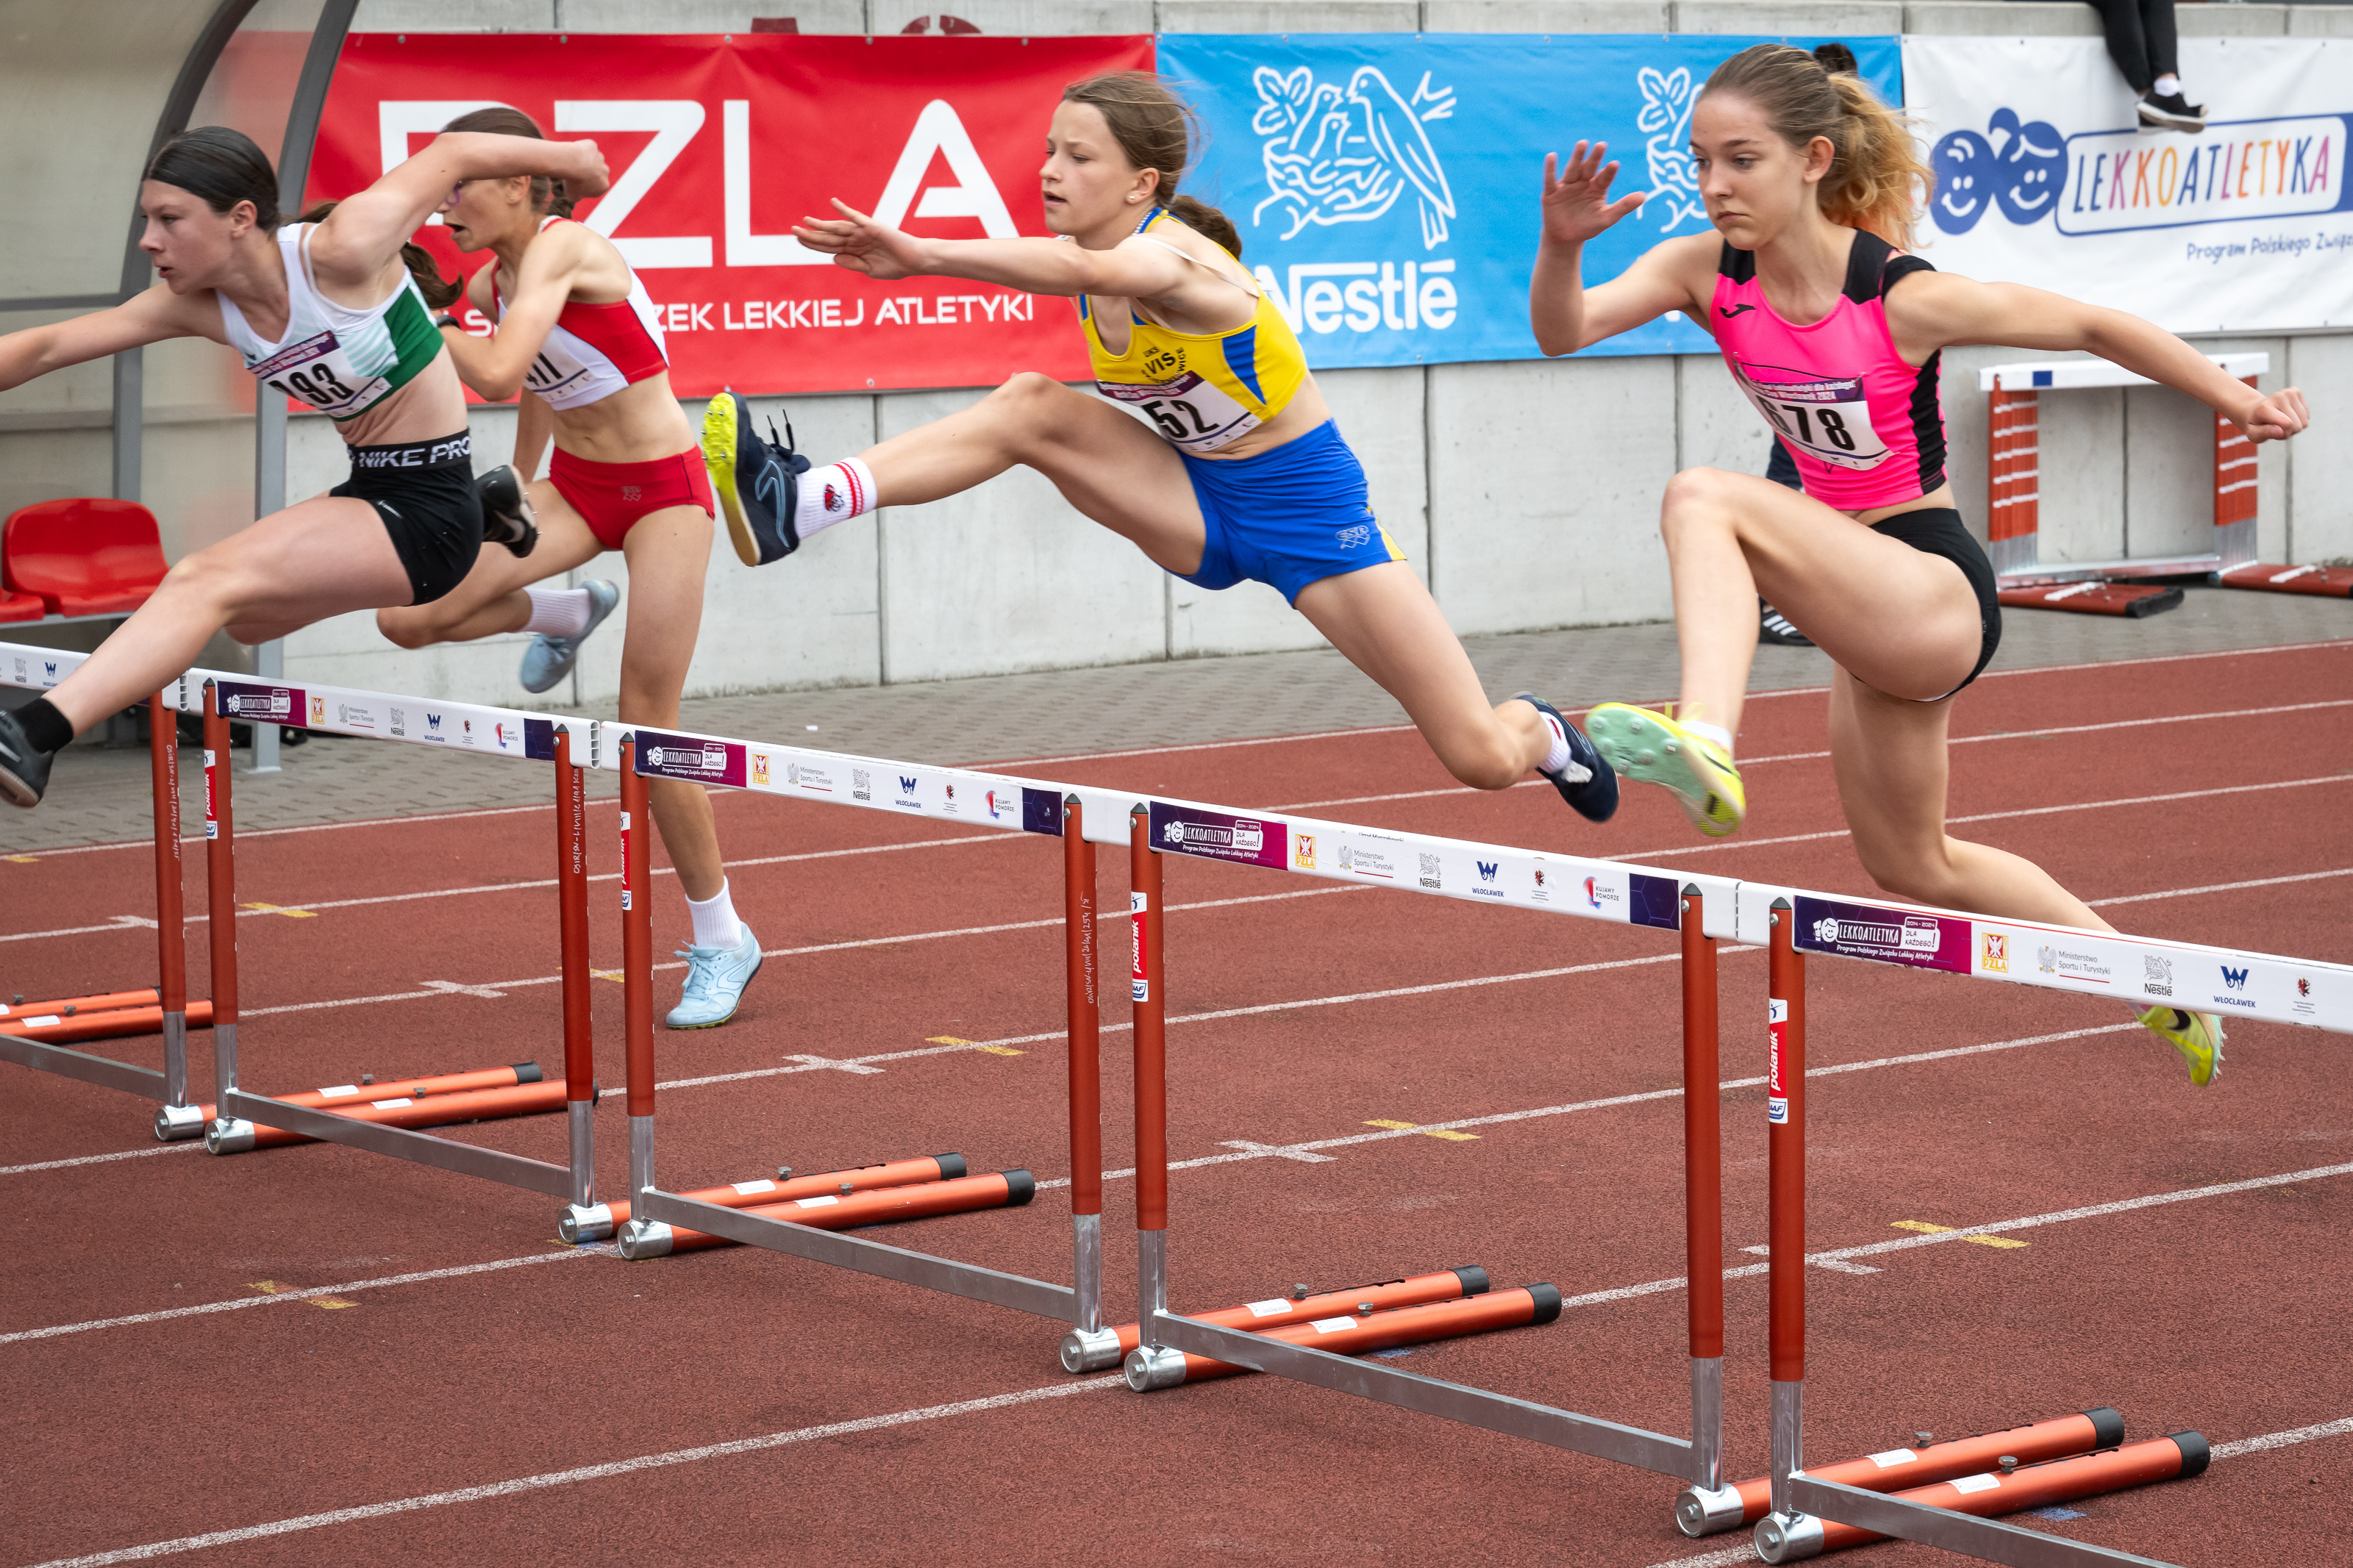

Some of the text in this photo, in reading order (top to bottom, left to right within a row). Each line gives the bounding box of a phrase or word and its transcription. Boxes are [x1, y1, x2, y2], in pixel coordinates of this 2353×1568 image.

[2073, 135, 2330, 212] LEKKOATLETYKA
[2187, 243, 2246, 265] Program
[2250, 234, 2311, 257] Polskiego
[1254, 259, 1458, 335] Nestlé
[724, 298, 864, 330] LEKKIEJ
[874, 294, 1033, 326] ATLETYKI
[1145, 352, 1176, 375] VIS
[1755, 395, 1856, 451] 678
[359, 448, 426, 468] NIKE
[429, 437, 471, 464] PRO
[800, 766, 824, 776] Ministerstwo
[753, 774, 769, 784] PZLA
[800, 774, 812, 782] Sportu
[815, 776, 832, 785] Turystyki
[895, 799, 921, 809] WŁOCŁAWEK
[1184, 827, 1231, 843] LEKKOATLETYKA
[1296, 856, 1315, 867] PZLA
[1354, 850, 1384, 861] Ministerstwo
[1354, 859, 1369, 867] Sportu
[1373, 861, 1394, 871] Turystyki
[1472, 887, 1504, 898] WŁOCŁAWEK
[1596, 886, 1615, 894] KUJAWY
[1596, 892, 1619, 901] POMORZE
[1838, 924, 1899, 944] LEKKOATLETYKA
[1132, 920, 1142, 973] polanik
[1836, 944, 1856, 953] Program
[2059, 951, 2098, 963] Ministerstwo
[1983, 959, 2007, 971] PZLA
[2059, 961, 2079, 972] Sportu
[2082, 963, 2111, 975] Turystyki
[2213, 995, 2256, 1008] WŁOCŁAWEK
[1769, 1030, 1782, 1092] polanik
